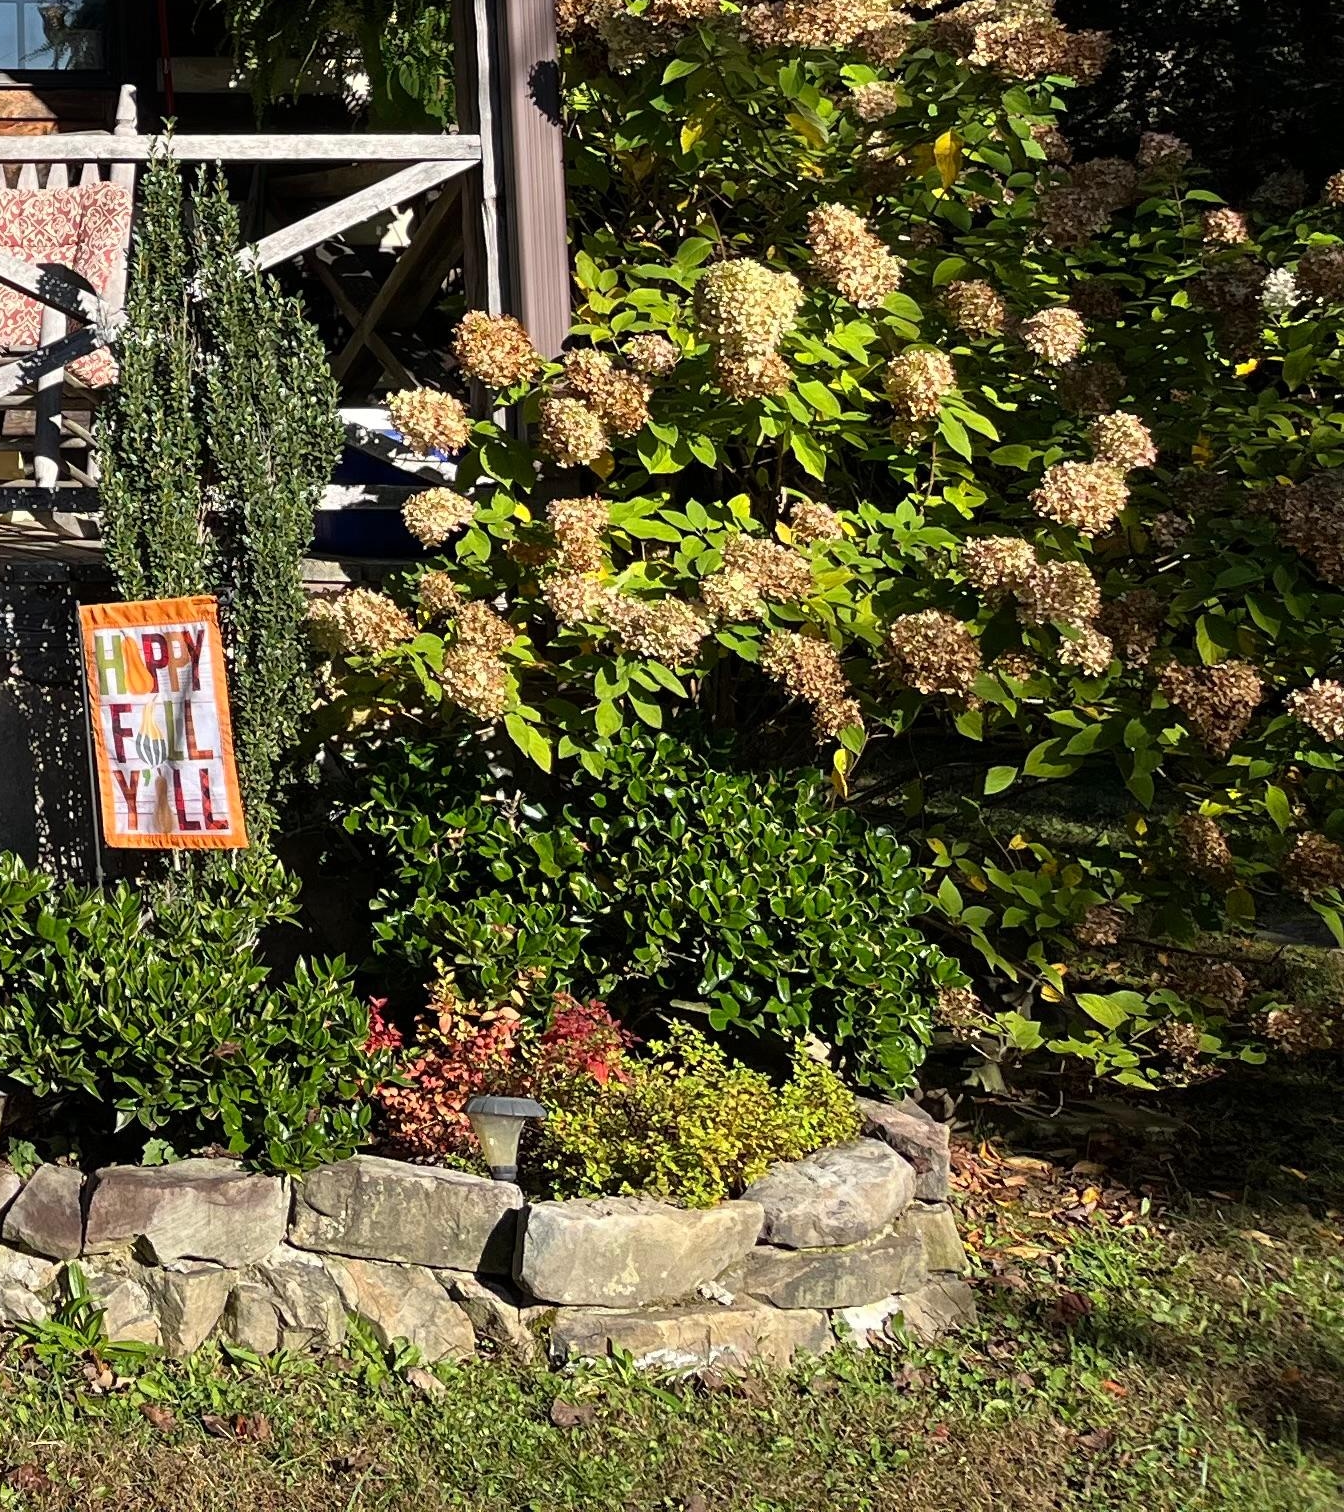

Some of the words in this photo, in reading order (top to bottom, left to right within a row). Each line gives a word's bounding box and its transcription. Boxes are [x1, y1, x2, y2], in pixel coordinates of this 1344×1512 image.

[94, 629, 205, 696] HPPY
[109, 699, 214, 763] FLL
[113, 768, 229, 831] Y'LL
